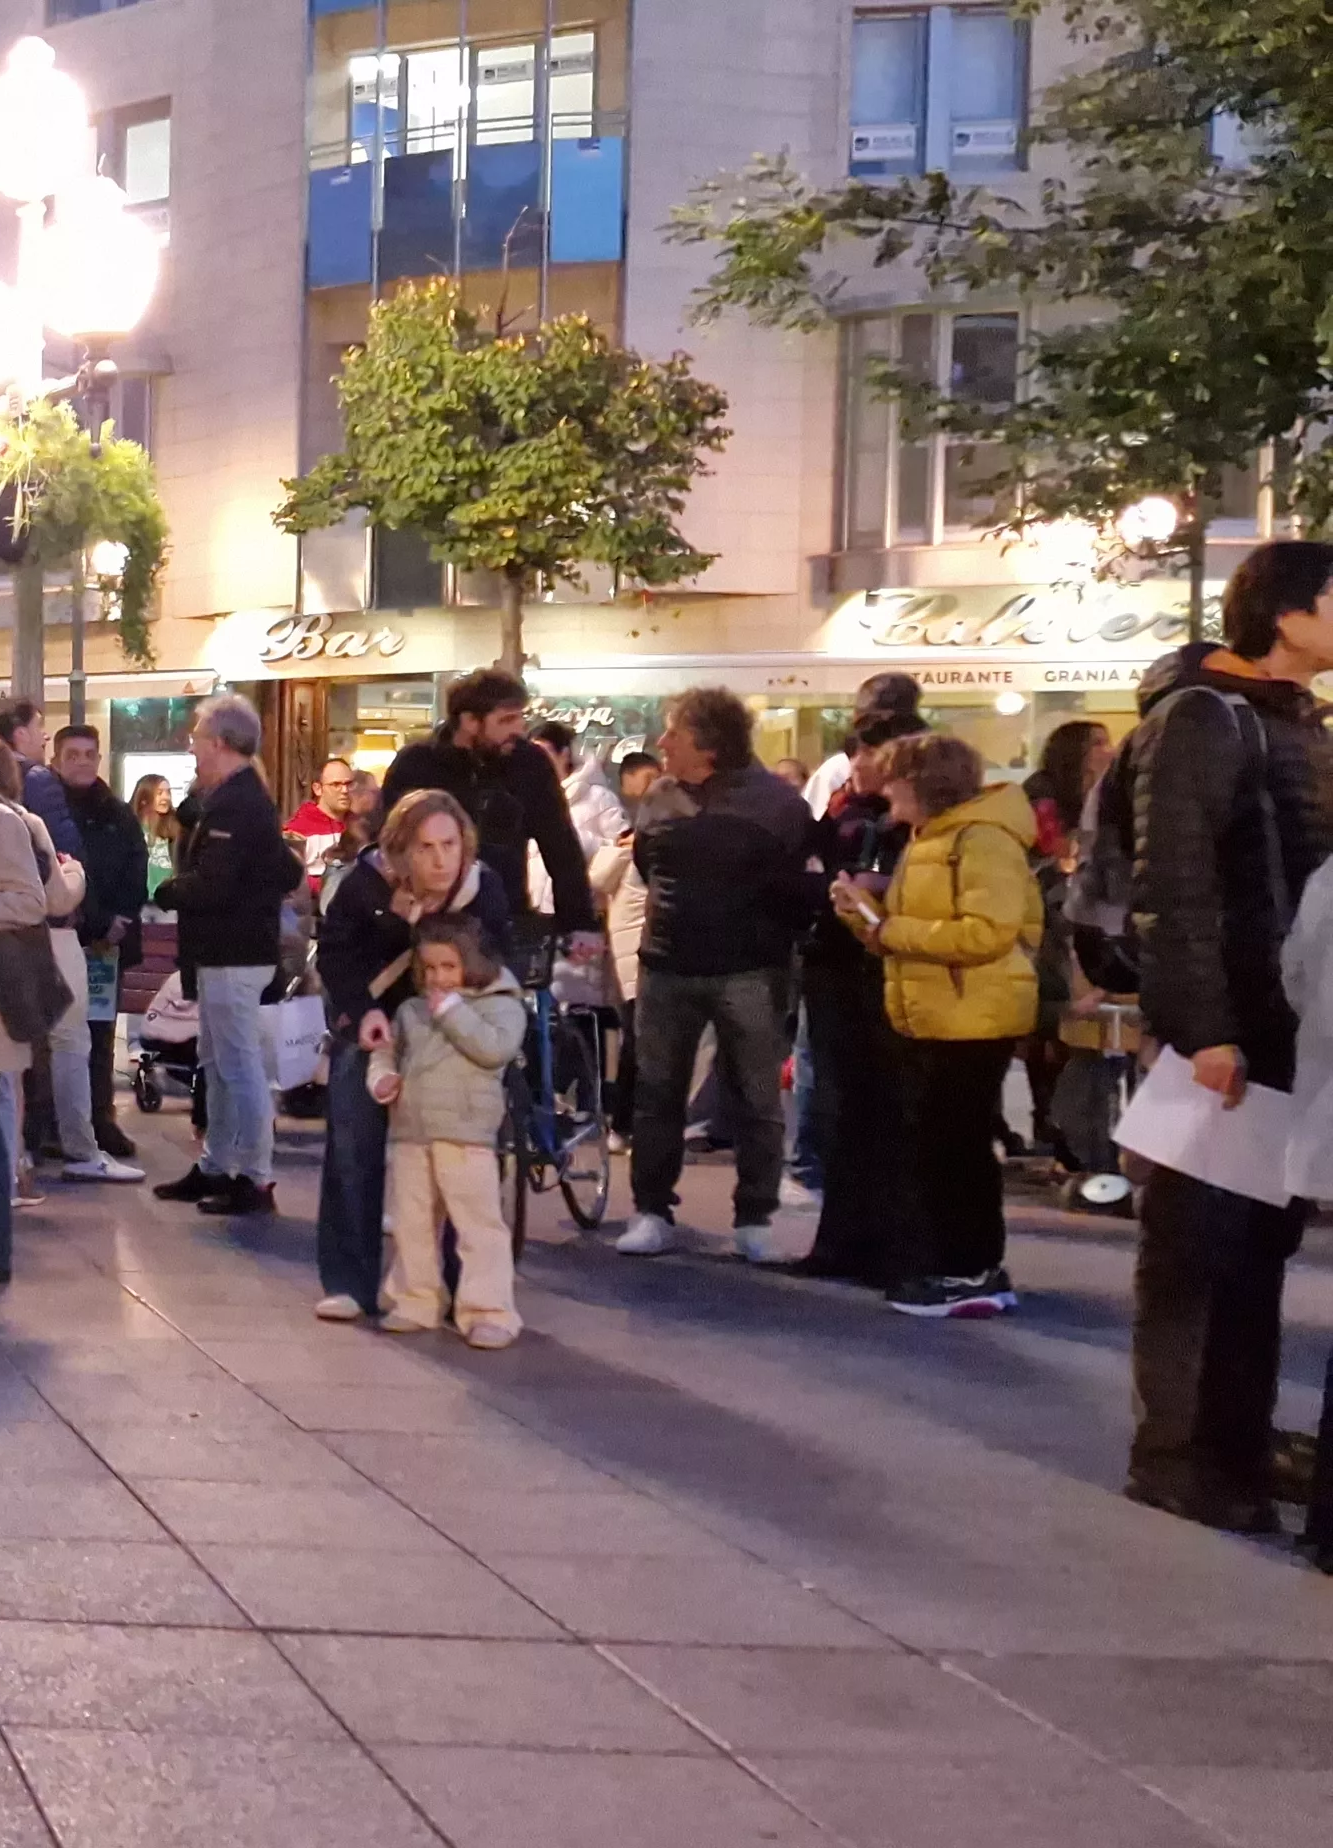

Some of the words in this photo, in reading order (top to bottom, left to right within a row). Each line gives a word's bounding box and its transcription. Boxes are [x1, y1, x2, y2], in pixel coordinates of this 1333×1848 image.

[258, 613, 406, 662] Bar
[915, 671, 1013, 684] TAURANTE
[1045, 669, 1120, 683] GRANJA
